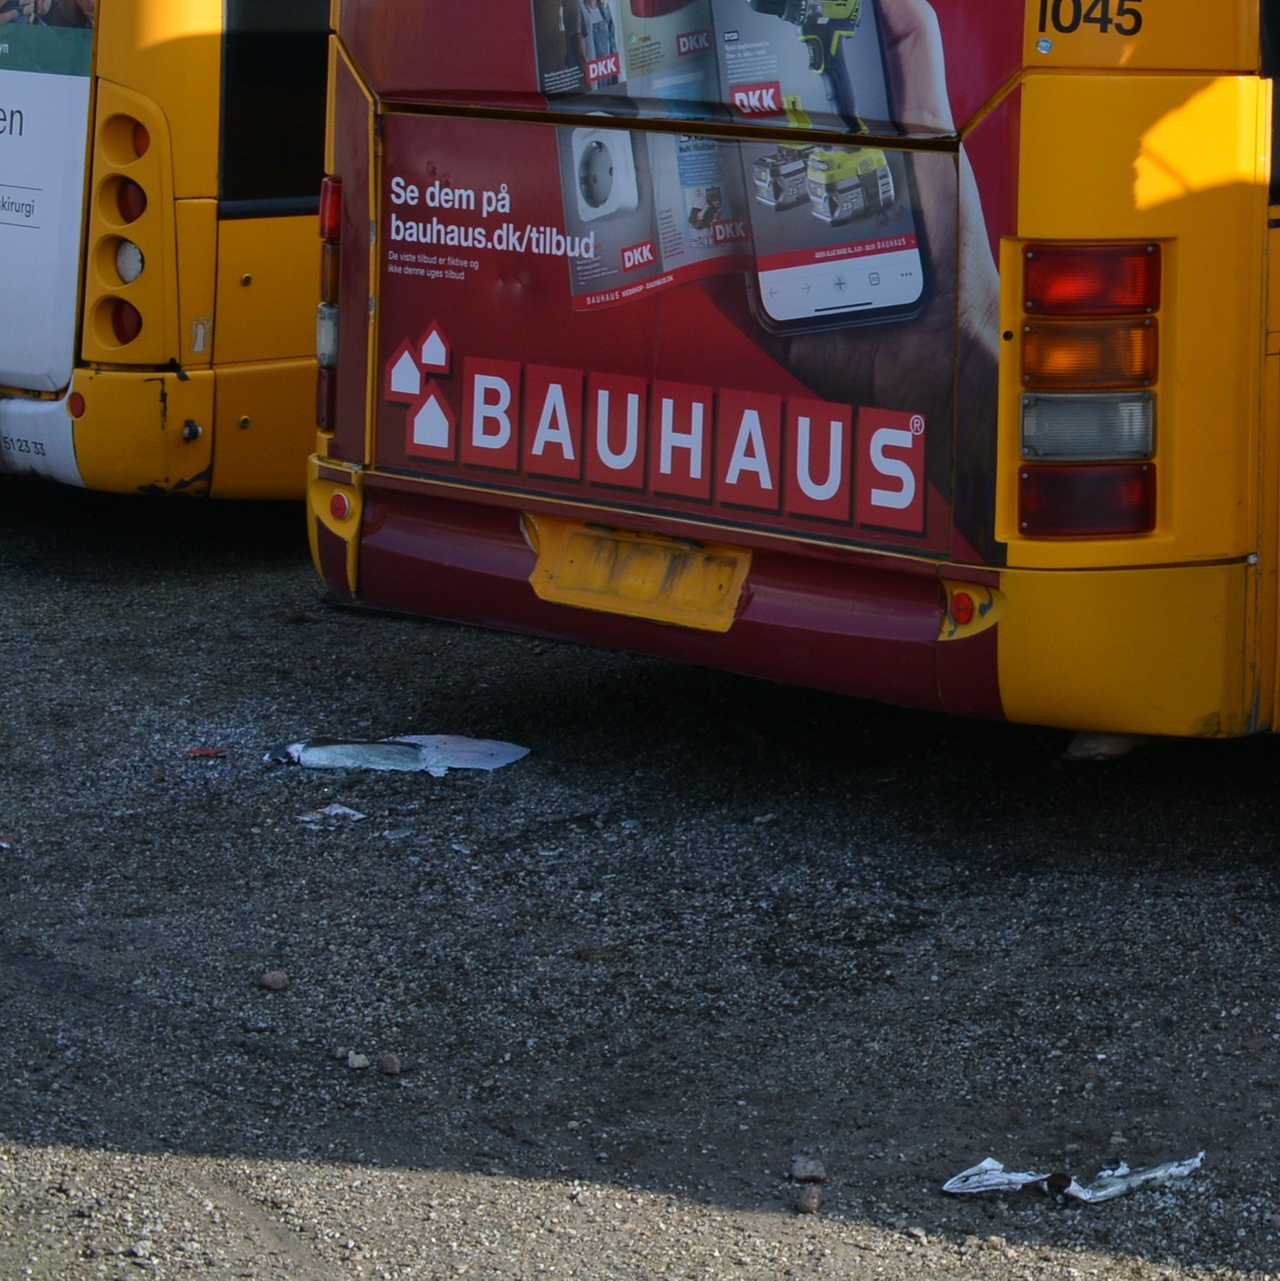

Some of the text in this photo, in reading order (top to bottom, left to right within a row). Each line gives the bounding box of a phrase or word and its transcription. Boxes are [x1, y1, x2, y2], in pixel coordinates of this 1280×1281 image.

[679, 33, 709, 53] DKK
[589, 57, 617, 79] DKK
[735, 88, 778, 113] DKK
[391, 176, 510, 218] Se dem på
[391, 214, 594, 259] bauhaus.dk/tilbud
[715, 221, 746, 241] DKK
[389, 251, 398, 261] De
[400, 253, 416, 264] viste
[417, 254, 437, 265] tilbud
[438, 257, 446, 265] er
[470, 260, 479, 270] og
[624, 244, 653, 268] DKK
[388, 263, 464, 280] ikke denne uges tilbud
[586, 290, 620, 305] BAUHAUS
[17, 438, 31, 454] 23
[32, 441, 46, 457] 33
